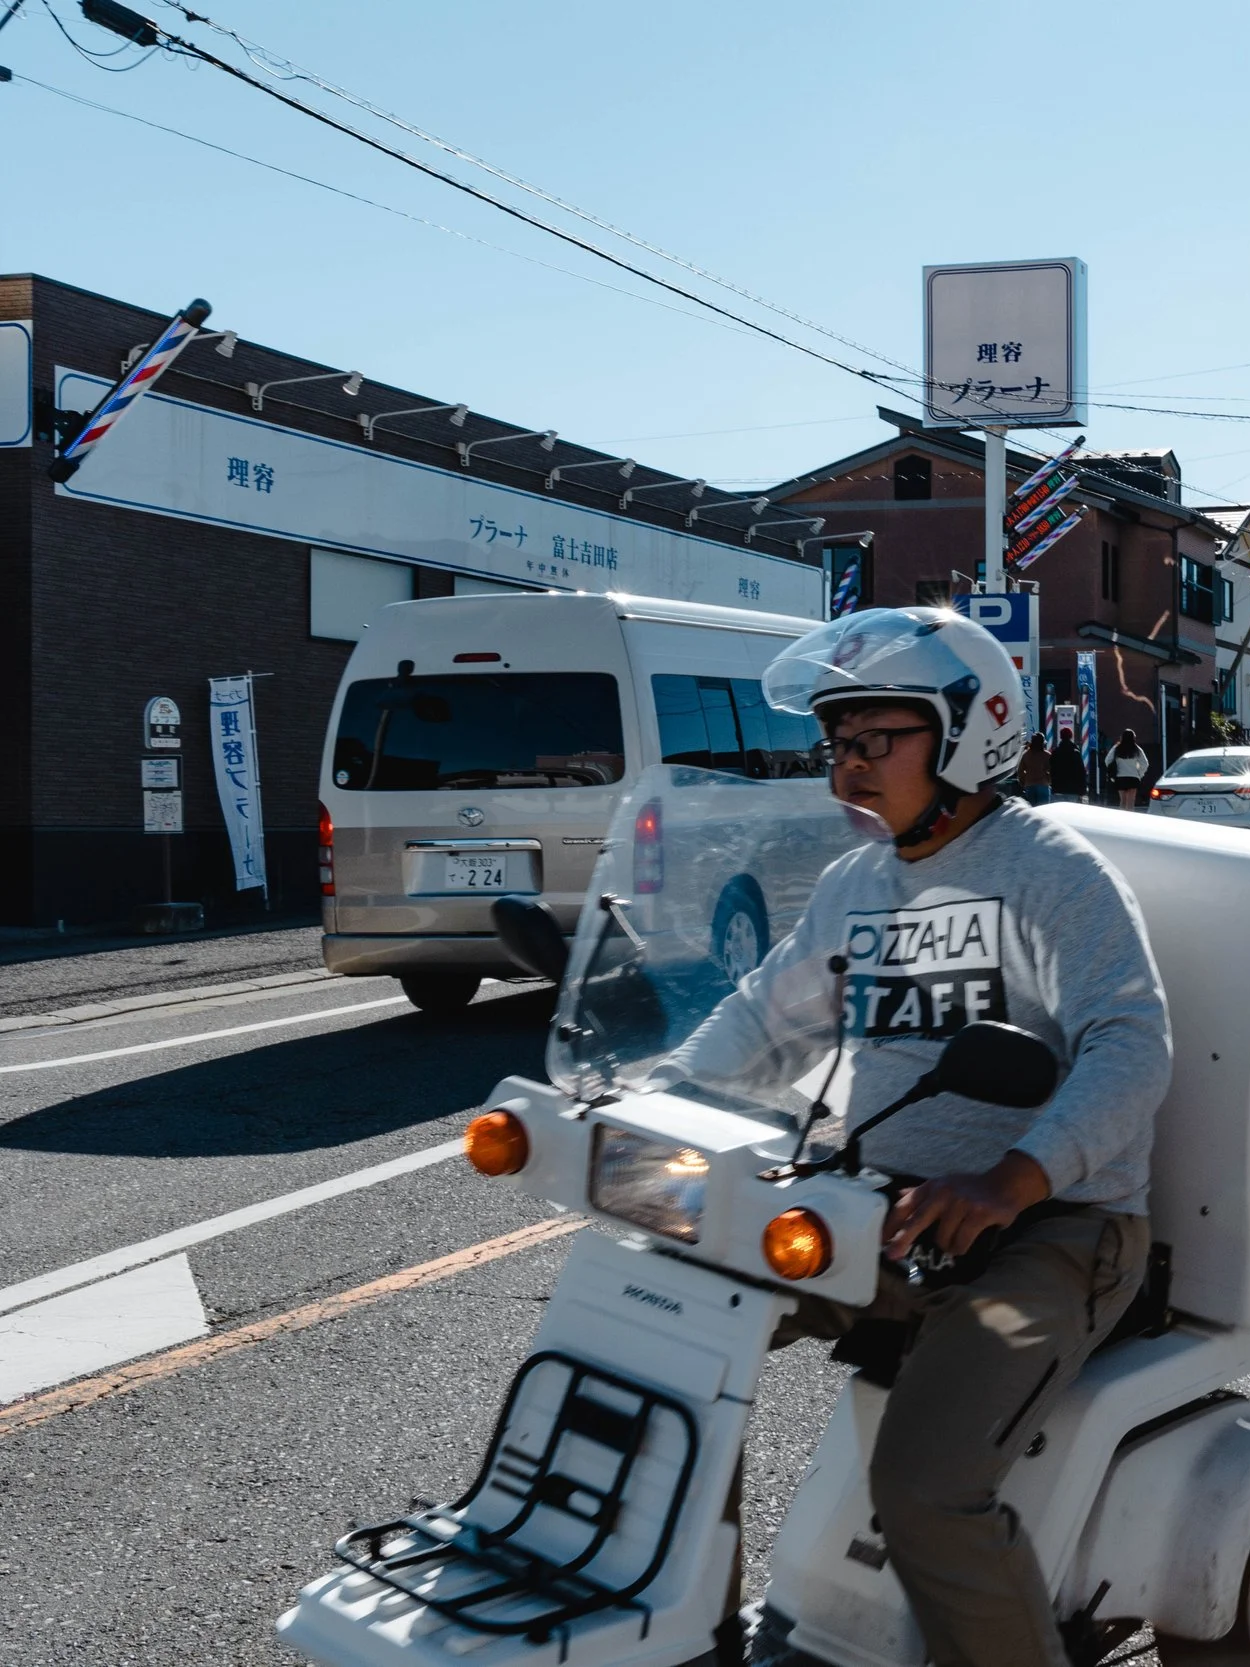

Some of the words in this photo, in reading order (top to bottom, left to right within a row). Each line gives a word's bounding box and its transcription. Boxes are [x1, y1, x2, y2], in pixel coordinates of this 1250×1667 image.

[977, 341, 1023, 363] 理容
[950, 376, 1050, 405] プラーナ
[227, 456, 275, 494] 理容
[469, 514, 528, 548] プラーナ
[552, 534, 618, 571] 富士吉田店
[738, 577, 760, 600] 理容
[970, 597, 1012, 626] P
[843, 980, 991, 1029] STAFF
[622, 1284, 684, 1316] HONDA
